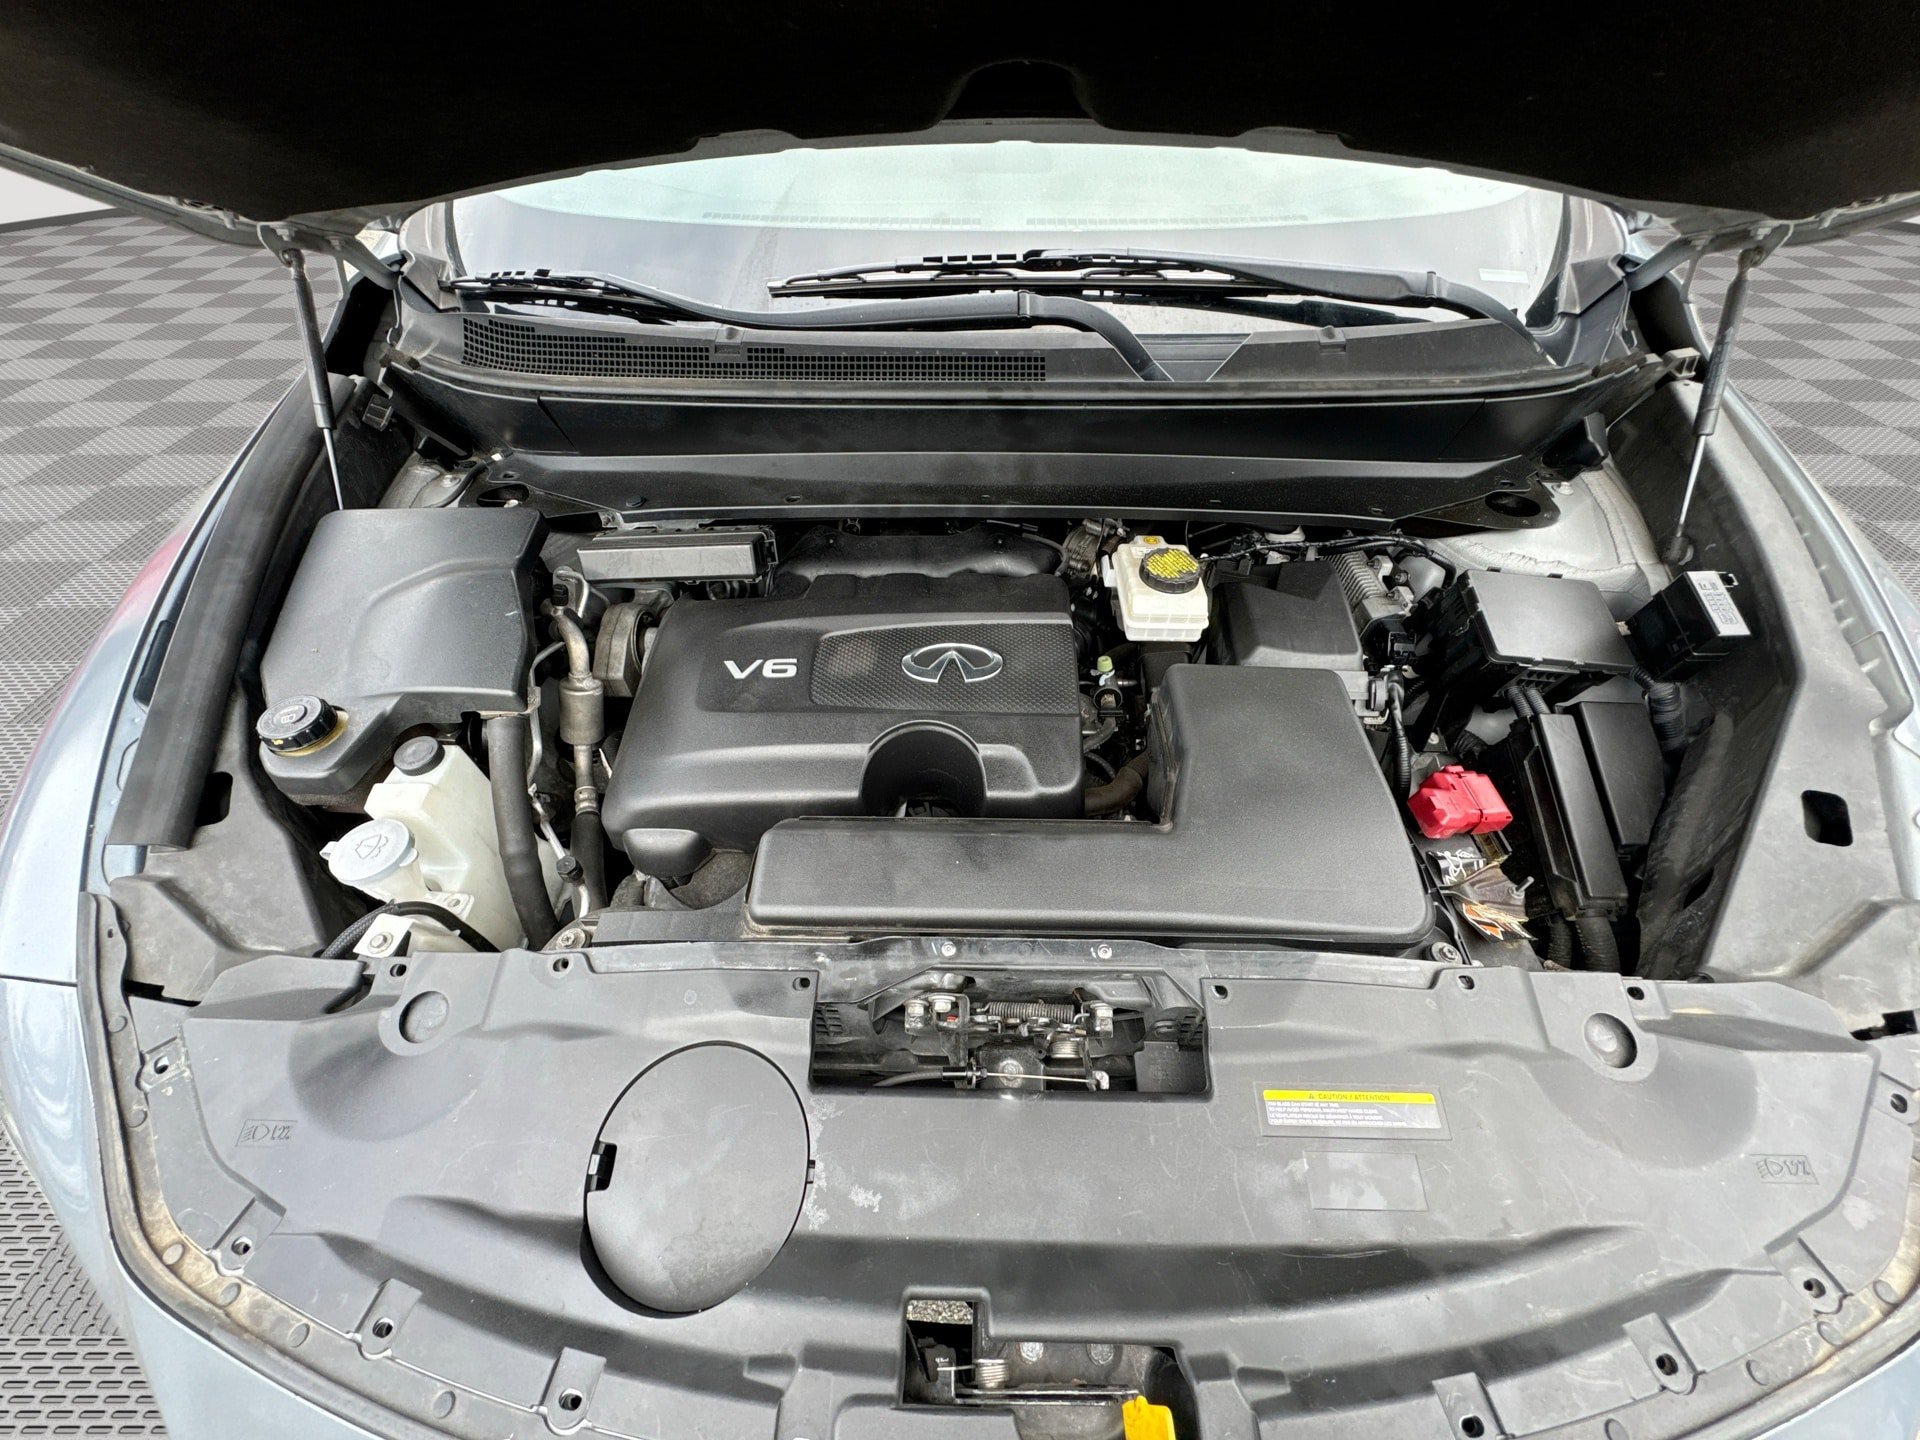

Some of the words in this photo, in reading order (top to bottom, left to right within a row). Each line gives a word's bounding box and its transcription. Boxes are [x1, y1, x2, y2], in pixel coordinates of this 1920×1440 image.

[724, 658, 797, 679] V6
[1319, 1093, 1348, 1101] CAUTION
[1355, 1094, 1391, 1102] ATTENTION
